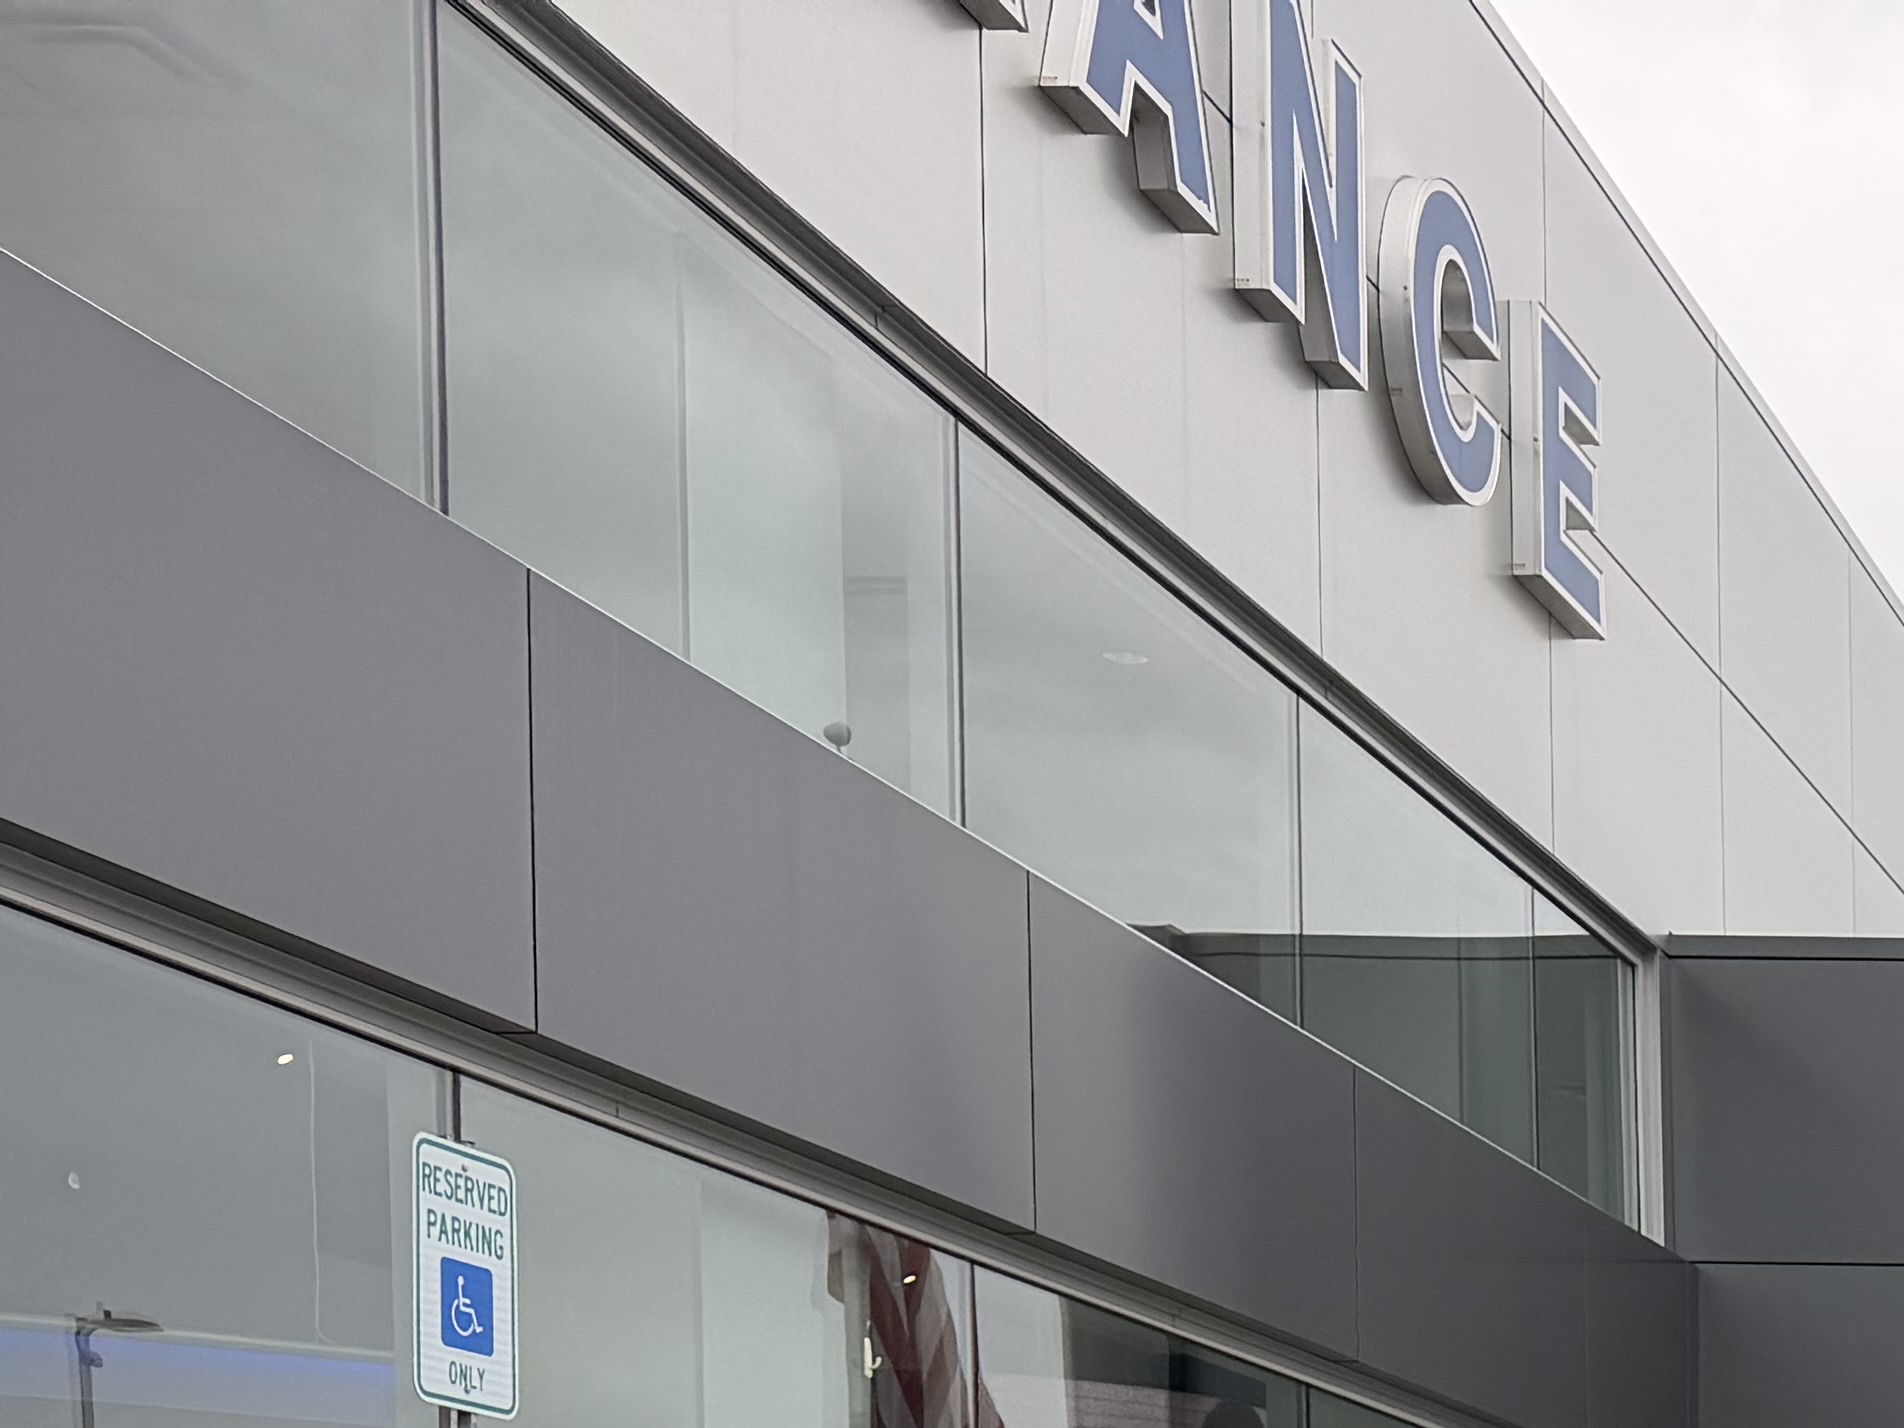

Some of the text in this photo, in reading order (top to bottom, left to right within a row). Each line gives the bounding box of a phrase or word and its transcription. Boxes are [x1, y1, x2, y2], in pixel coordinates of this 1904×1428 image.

[960, 0, 1606, 640] ANCE
[421, 1161, 508, 1217] RESERVED
[426, 1208, 504, 1260] PARKING
[448, 1360, 486, 1392] ONLY
